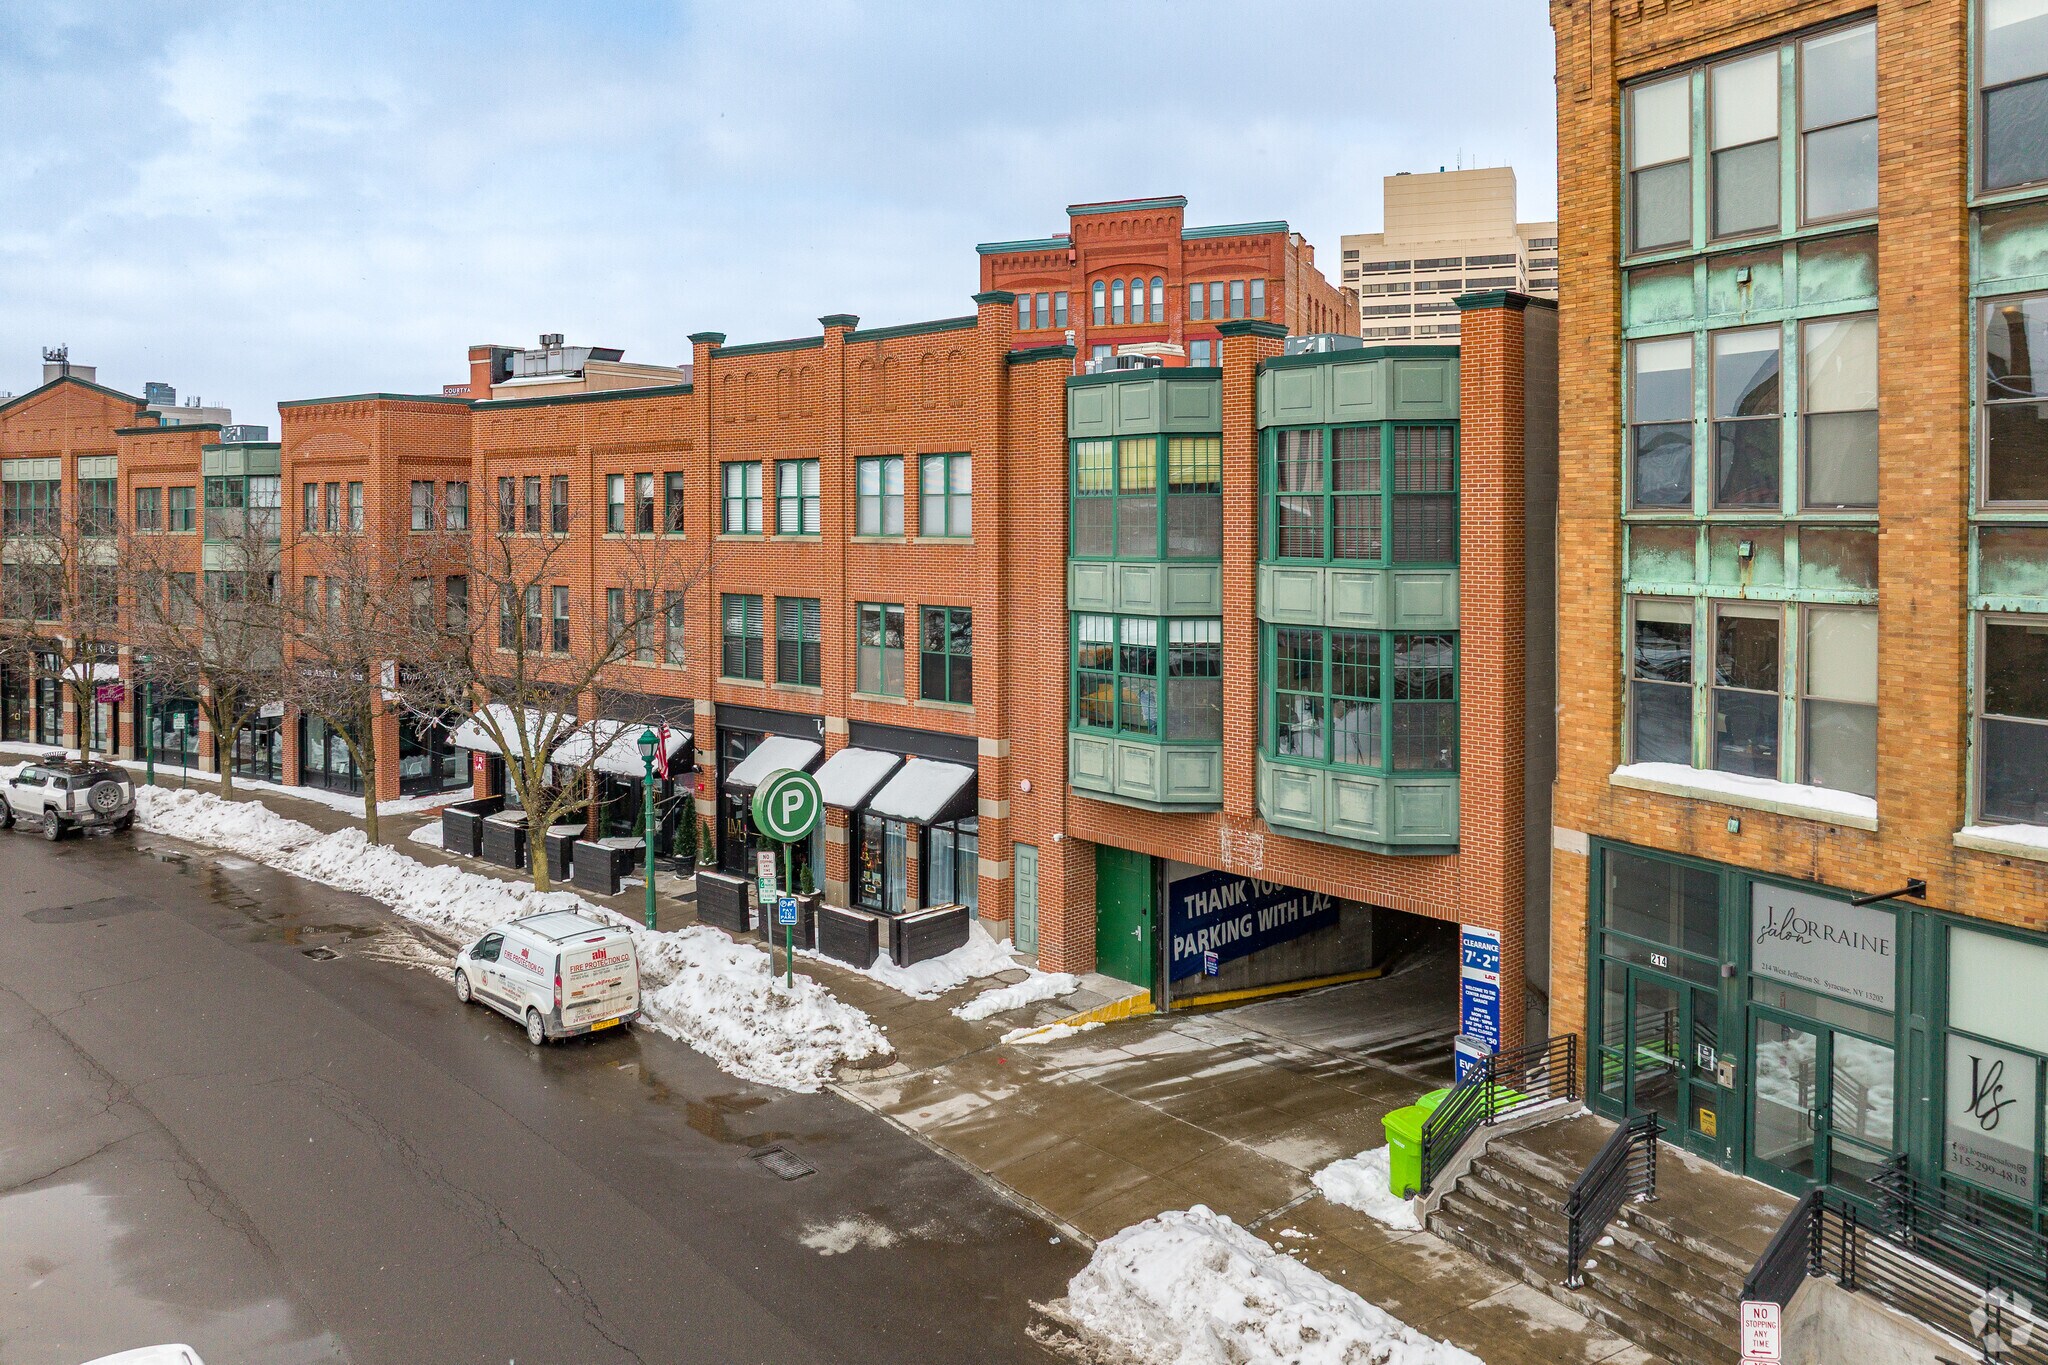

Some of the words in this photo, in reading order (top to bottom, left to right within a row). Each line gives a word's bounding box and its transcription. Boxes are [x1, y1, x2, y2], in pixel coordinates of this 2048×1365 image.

[782, 789, 804, 825] P
[1184, 879, 1247, 919] THANK
[1174, 914, 1253, 961] PARKING
[1257, 898, 1298, 932] WITH
[1302, 892, 1331, 917] LAZ
[1463, 938, 1499, 952] CLEARANCE
[504, 949, 513, 960] FIRE
[512, 955, 537, 972] PROTECTION
[570, 963, 583, 972] FIRE
[585, 956, 620, 969] PROTECTION
[1651, 953, 1667, 966] 214
[1465, 984, 1483, 993] WELCOME
[1761, 963, 1772, 971] 214
[1773, 966, 1786, 975] West
[1787, 970, 1812, 983] Jefferson
[1853, 988, 1863, 997] NY
[1865, 991, 1884, 1003] 13202
[1951, 1152, 2027, 1187] 315-299-4818
[1753, 1308, 1768, 1319] NO
[1745, 1320, 1777, 1329] STOPPING
[1753, 1340, 1769, 1348] TIME
